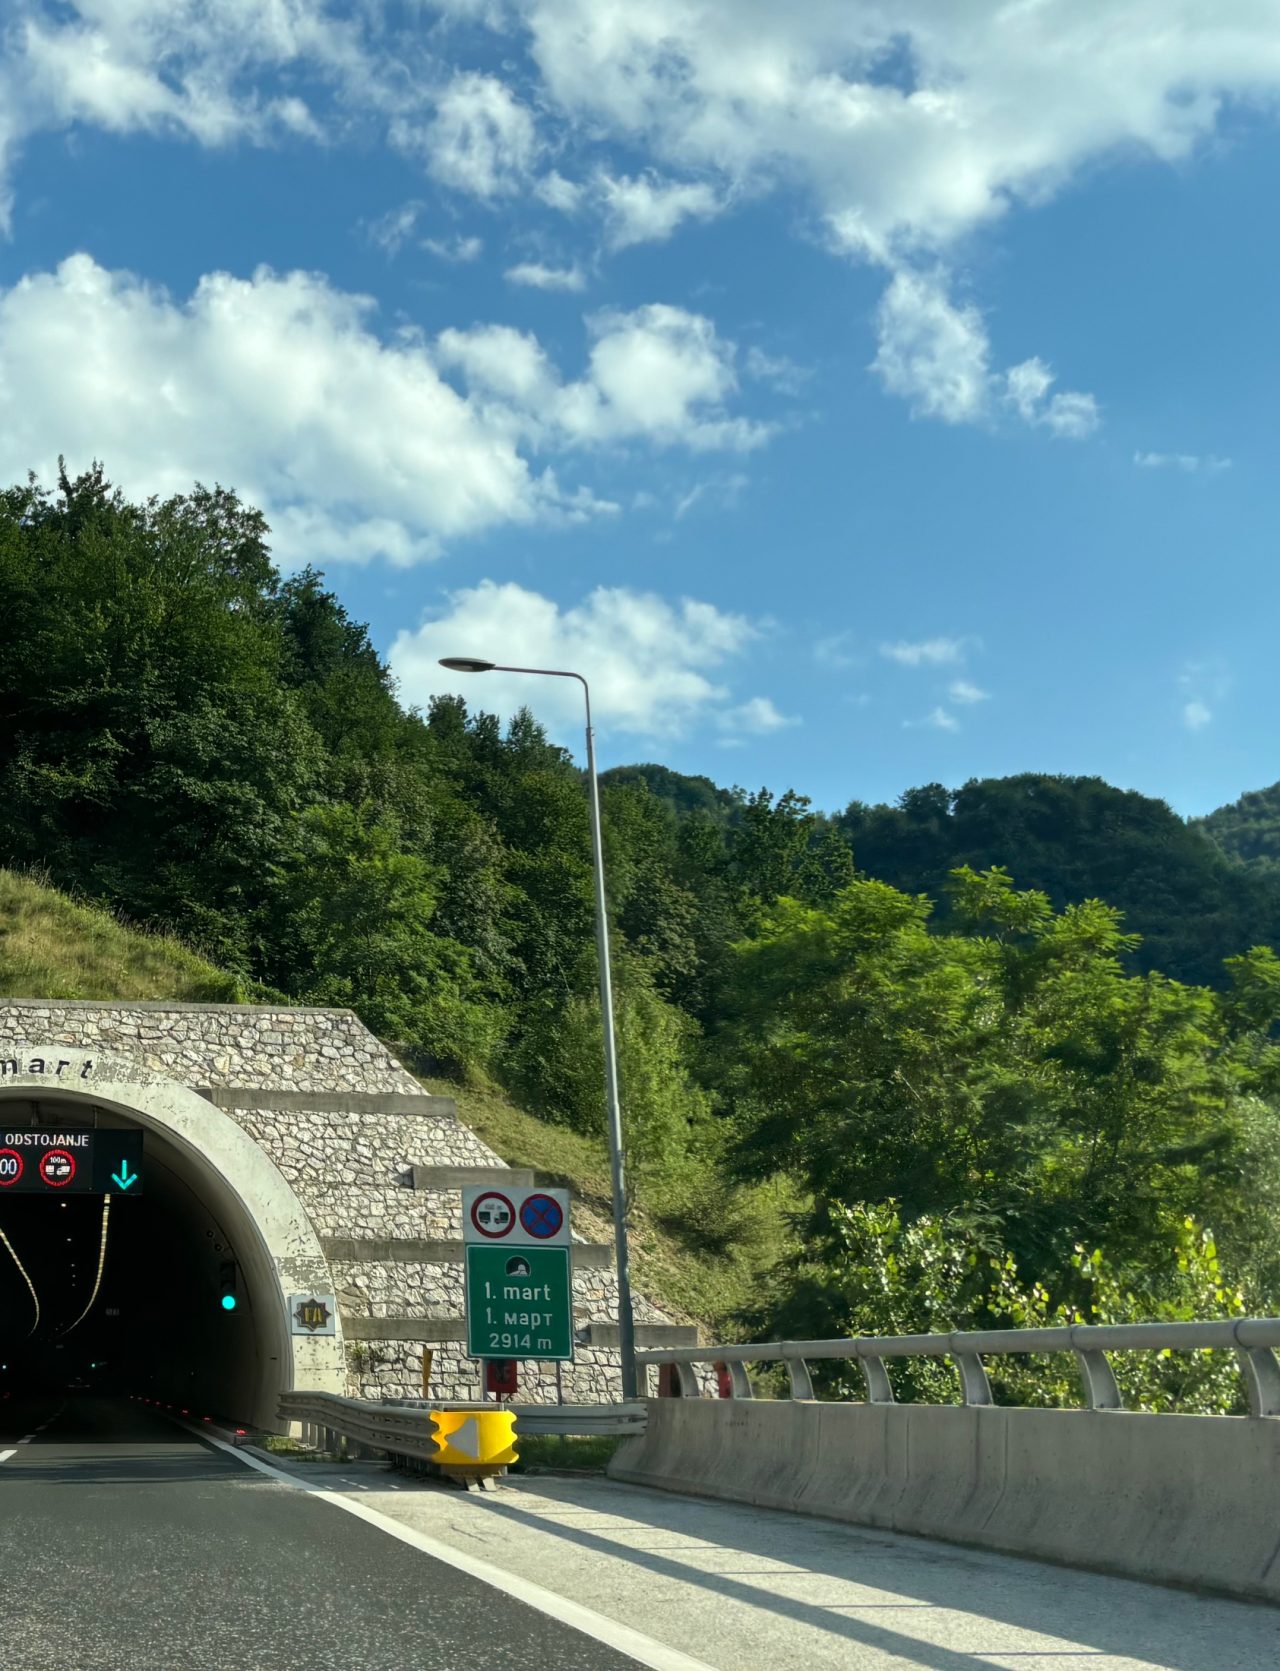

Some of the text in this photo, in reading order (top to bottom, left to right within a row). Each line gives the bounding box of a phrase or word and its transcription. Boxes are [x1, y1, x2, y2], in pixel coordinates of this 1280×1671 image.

[5, 1132, 90, 1147] ODSTOJANJE
[484, 1281, 551, 1301] 1. mart
[486, 1307, 553, 1330] 1. март
[489, 1333, 552, 1349] 2914 m
